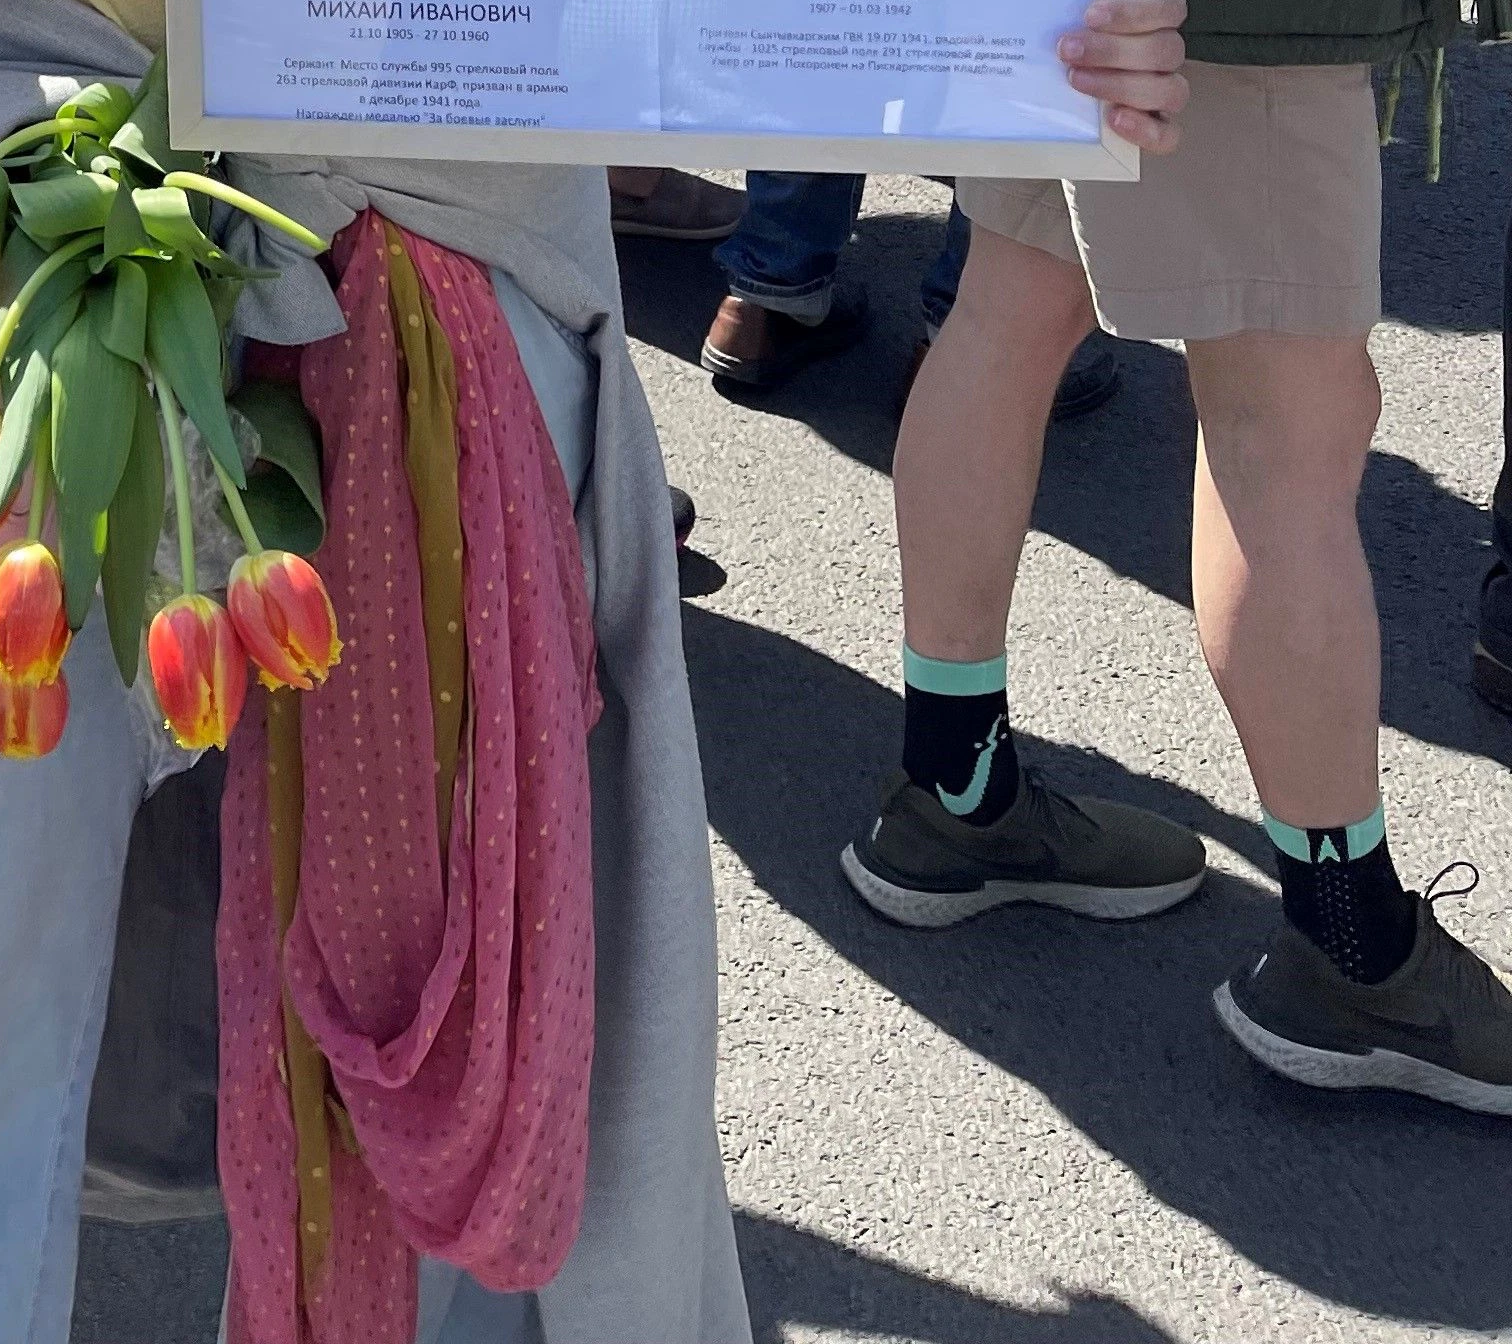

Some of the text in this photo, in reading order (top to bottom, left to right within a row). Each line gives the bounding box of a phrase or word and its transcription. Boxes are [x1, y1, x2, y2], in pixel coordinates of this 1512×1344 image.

[307, 0, 531, 23] МИХАИЛ ИВАНОВИЧ
[340, 59, 378, 71] Место
[381, 60, 428, 73] службы
[430, 62, 452, 73] 995
[455, 63, 527, 75] стрелковый
[530, 66, 560, 76] полк
[276, 74, 297, 85] 263
[300, 76, 368, 88] стрелковой
[371, 79, 423, 89] дивизии
[462, 82, 513, 93] призван
[516, 83, 523, 92] в
[526, 84, 569, 95] армию
[359, 95, 366, 104] в
[369, 95, 419, 107] декабре
[422, 95, 451, 107] 1941
[296, 108, 363, 121] Награжден
[365, 112, 421, 123] медалью
[446, 113, 492, 126] боевые
